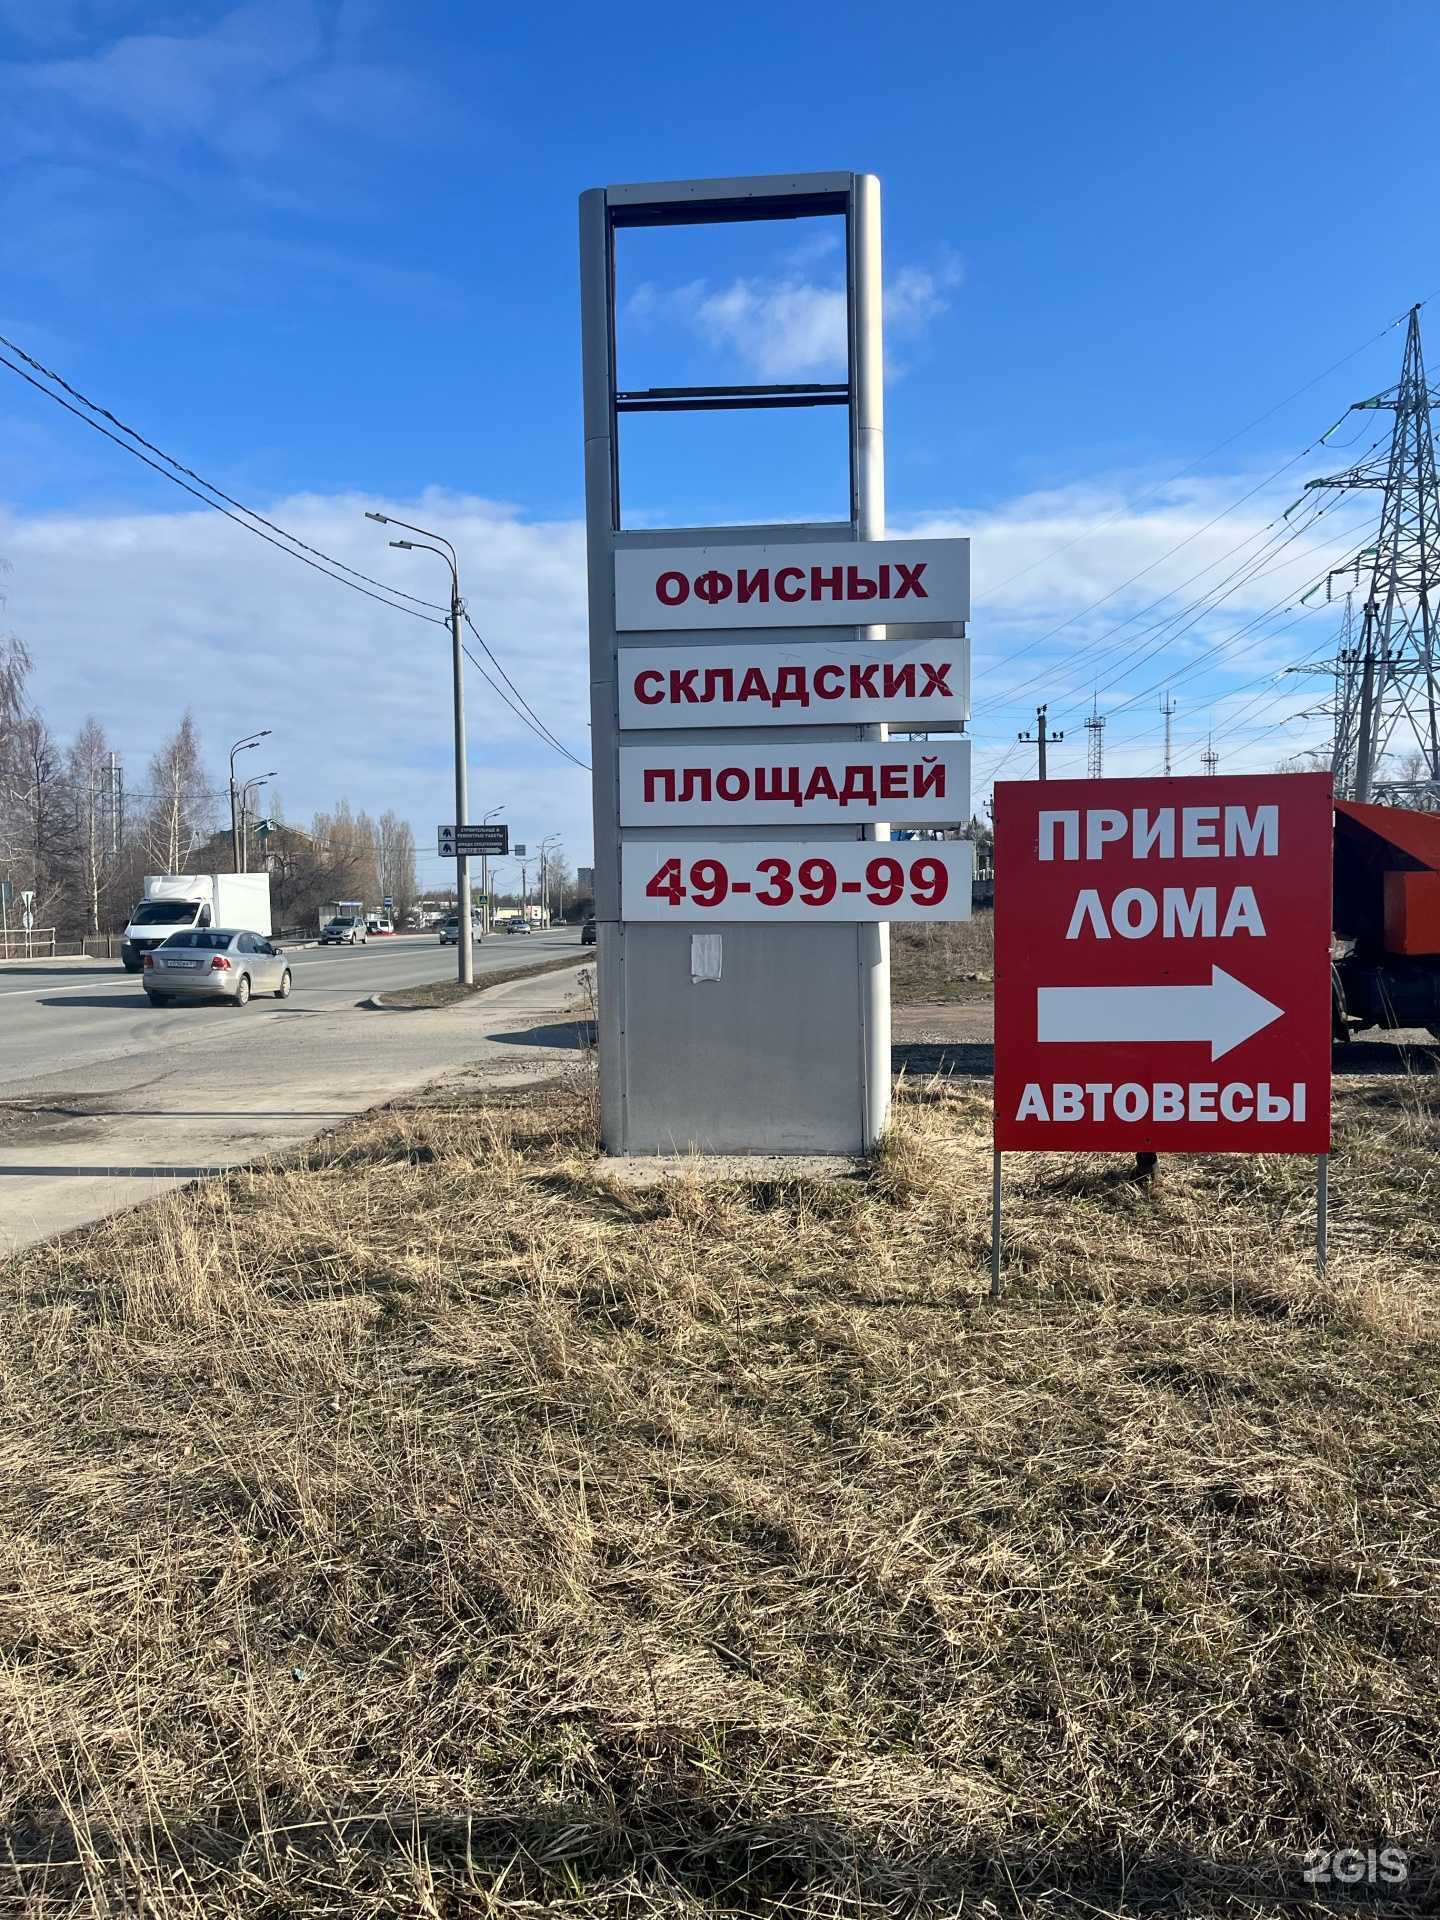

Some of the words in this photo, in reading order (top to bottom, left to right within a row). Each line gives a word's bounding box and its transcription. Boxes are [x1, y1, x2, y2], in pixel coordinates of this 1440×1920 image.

[655, 563, 929, 605] ОФИСНЫХ
[634, 663, 954, 707] СКЛАДСКИХ
[643, 756, 946, 807] ПЛОЩАДЕЙ
[1038, 805, 1279, 861] ПРИЕМ
[646, 857, 949, 908] 49-39-99
[1065, 886, 1267, 940] ЛОМА
[1015, 1082, 1306, 1122] АВТОВЕСЫ
